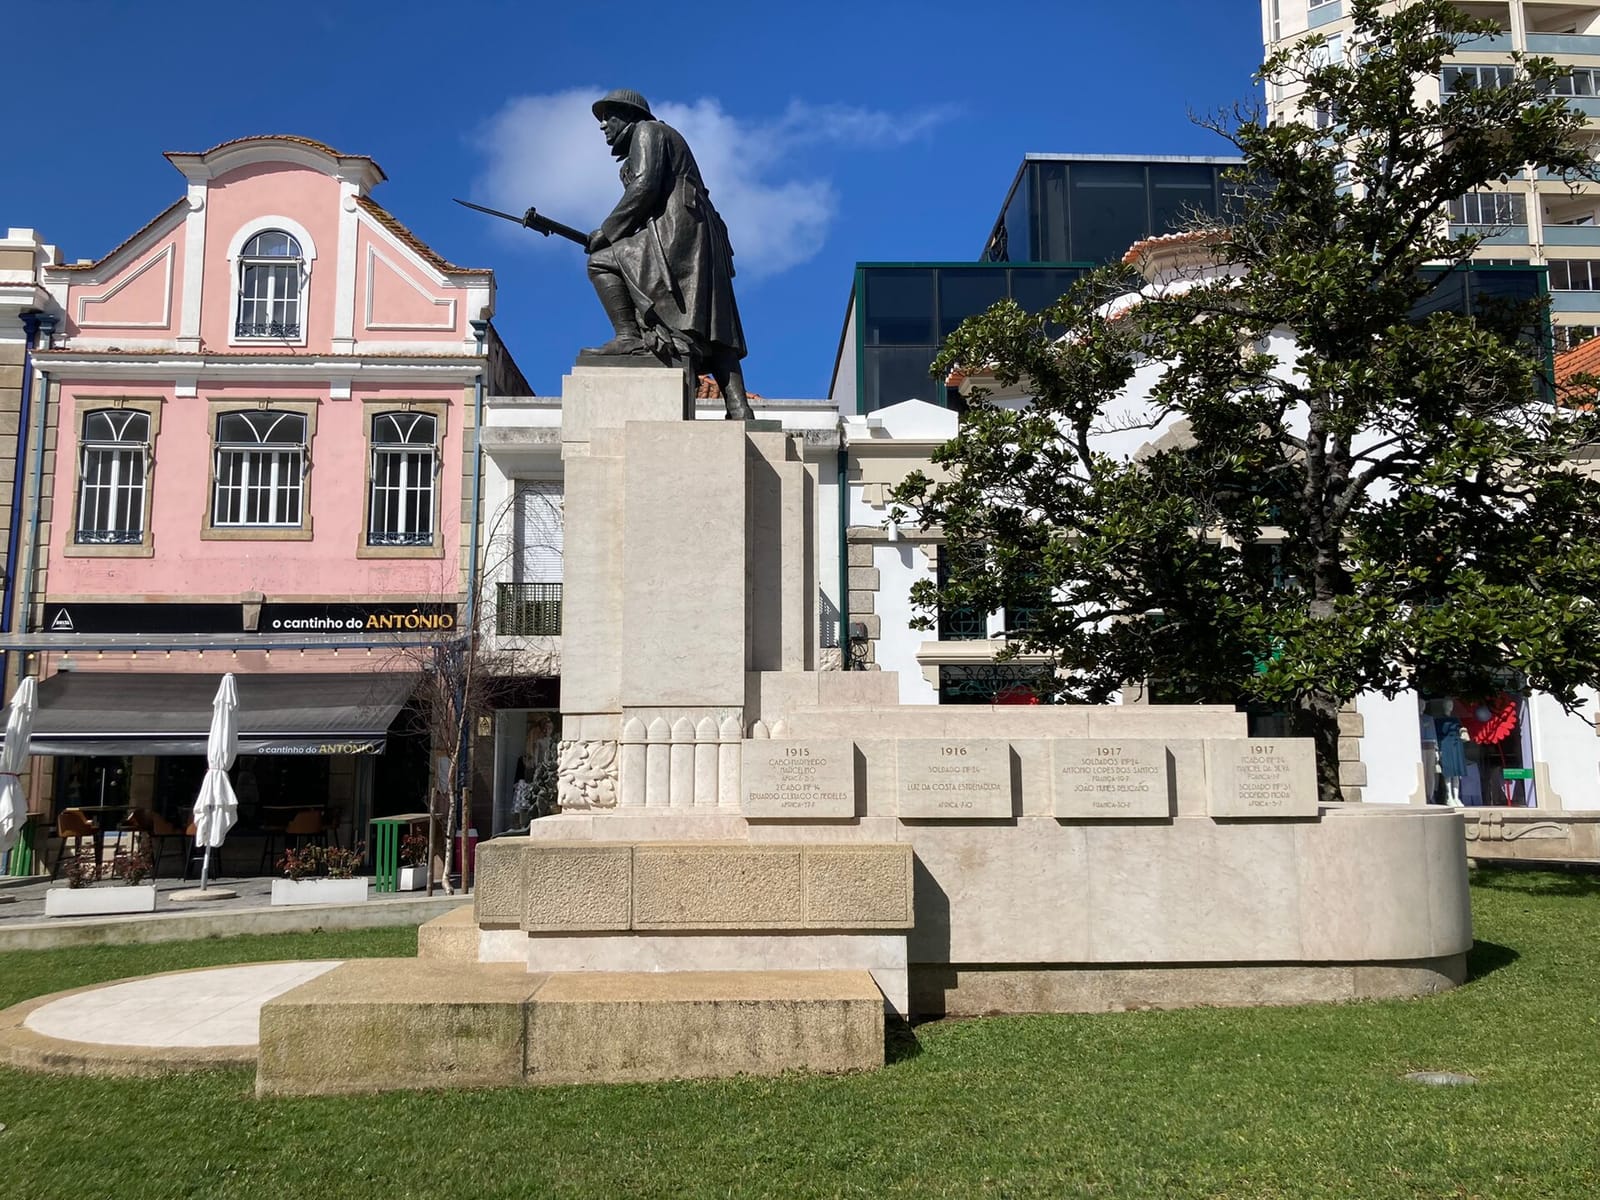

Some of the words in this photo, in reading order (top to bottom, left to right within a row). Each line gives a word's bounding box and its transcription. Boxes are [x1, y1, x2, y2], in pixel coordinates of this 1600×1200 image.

[272, 618, 281, 629] o
[283, 617, 344, 629] cantinho
[346, 617, 363, 629] do
[366, 609, 453, 629] ANTÓNIO
[265, 746, 304, 754] cantinho
[305, 746, 317, 754] do
[785, 748, 810, 756] 1915
[941, 747, 967, 756] 1916
[1097, 747, 1122, 756] 1917
[1250, 745, 1274, 754] 1917
